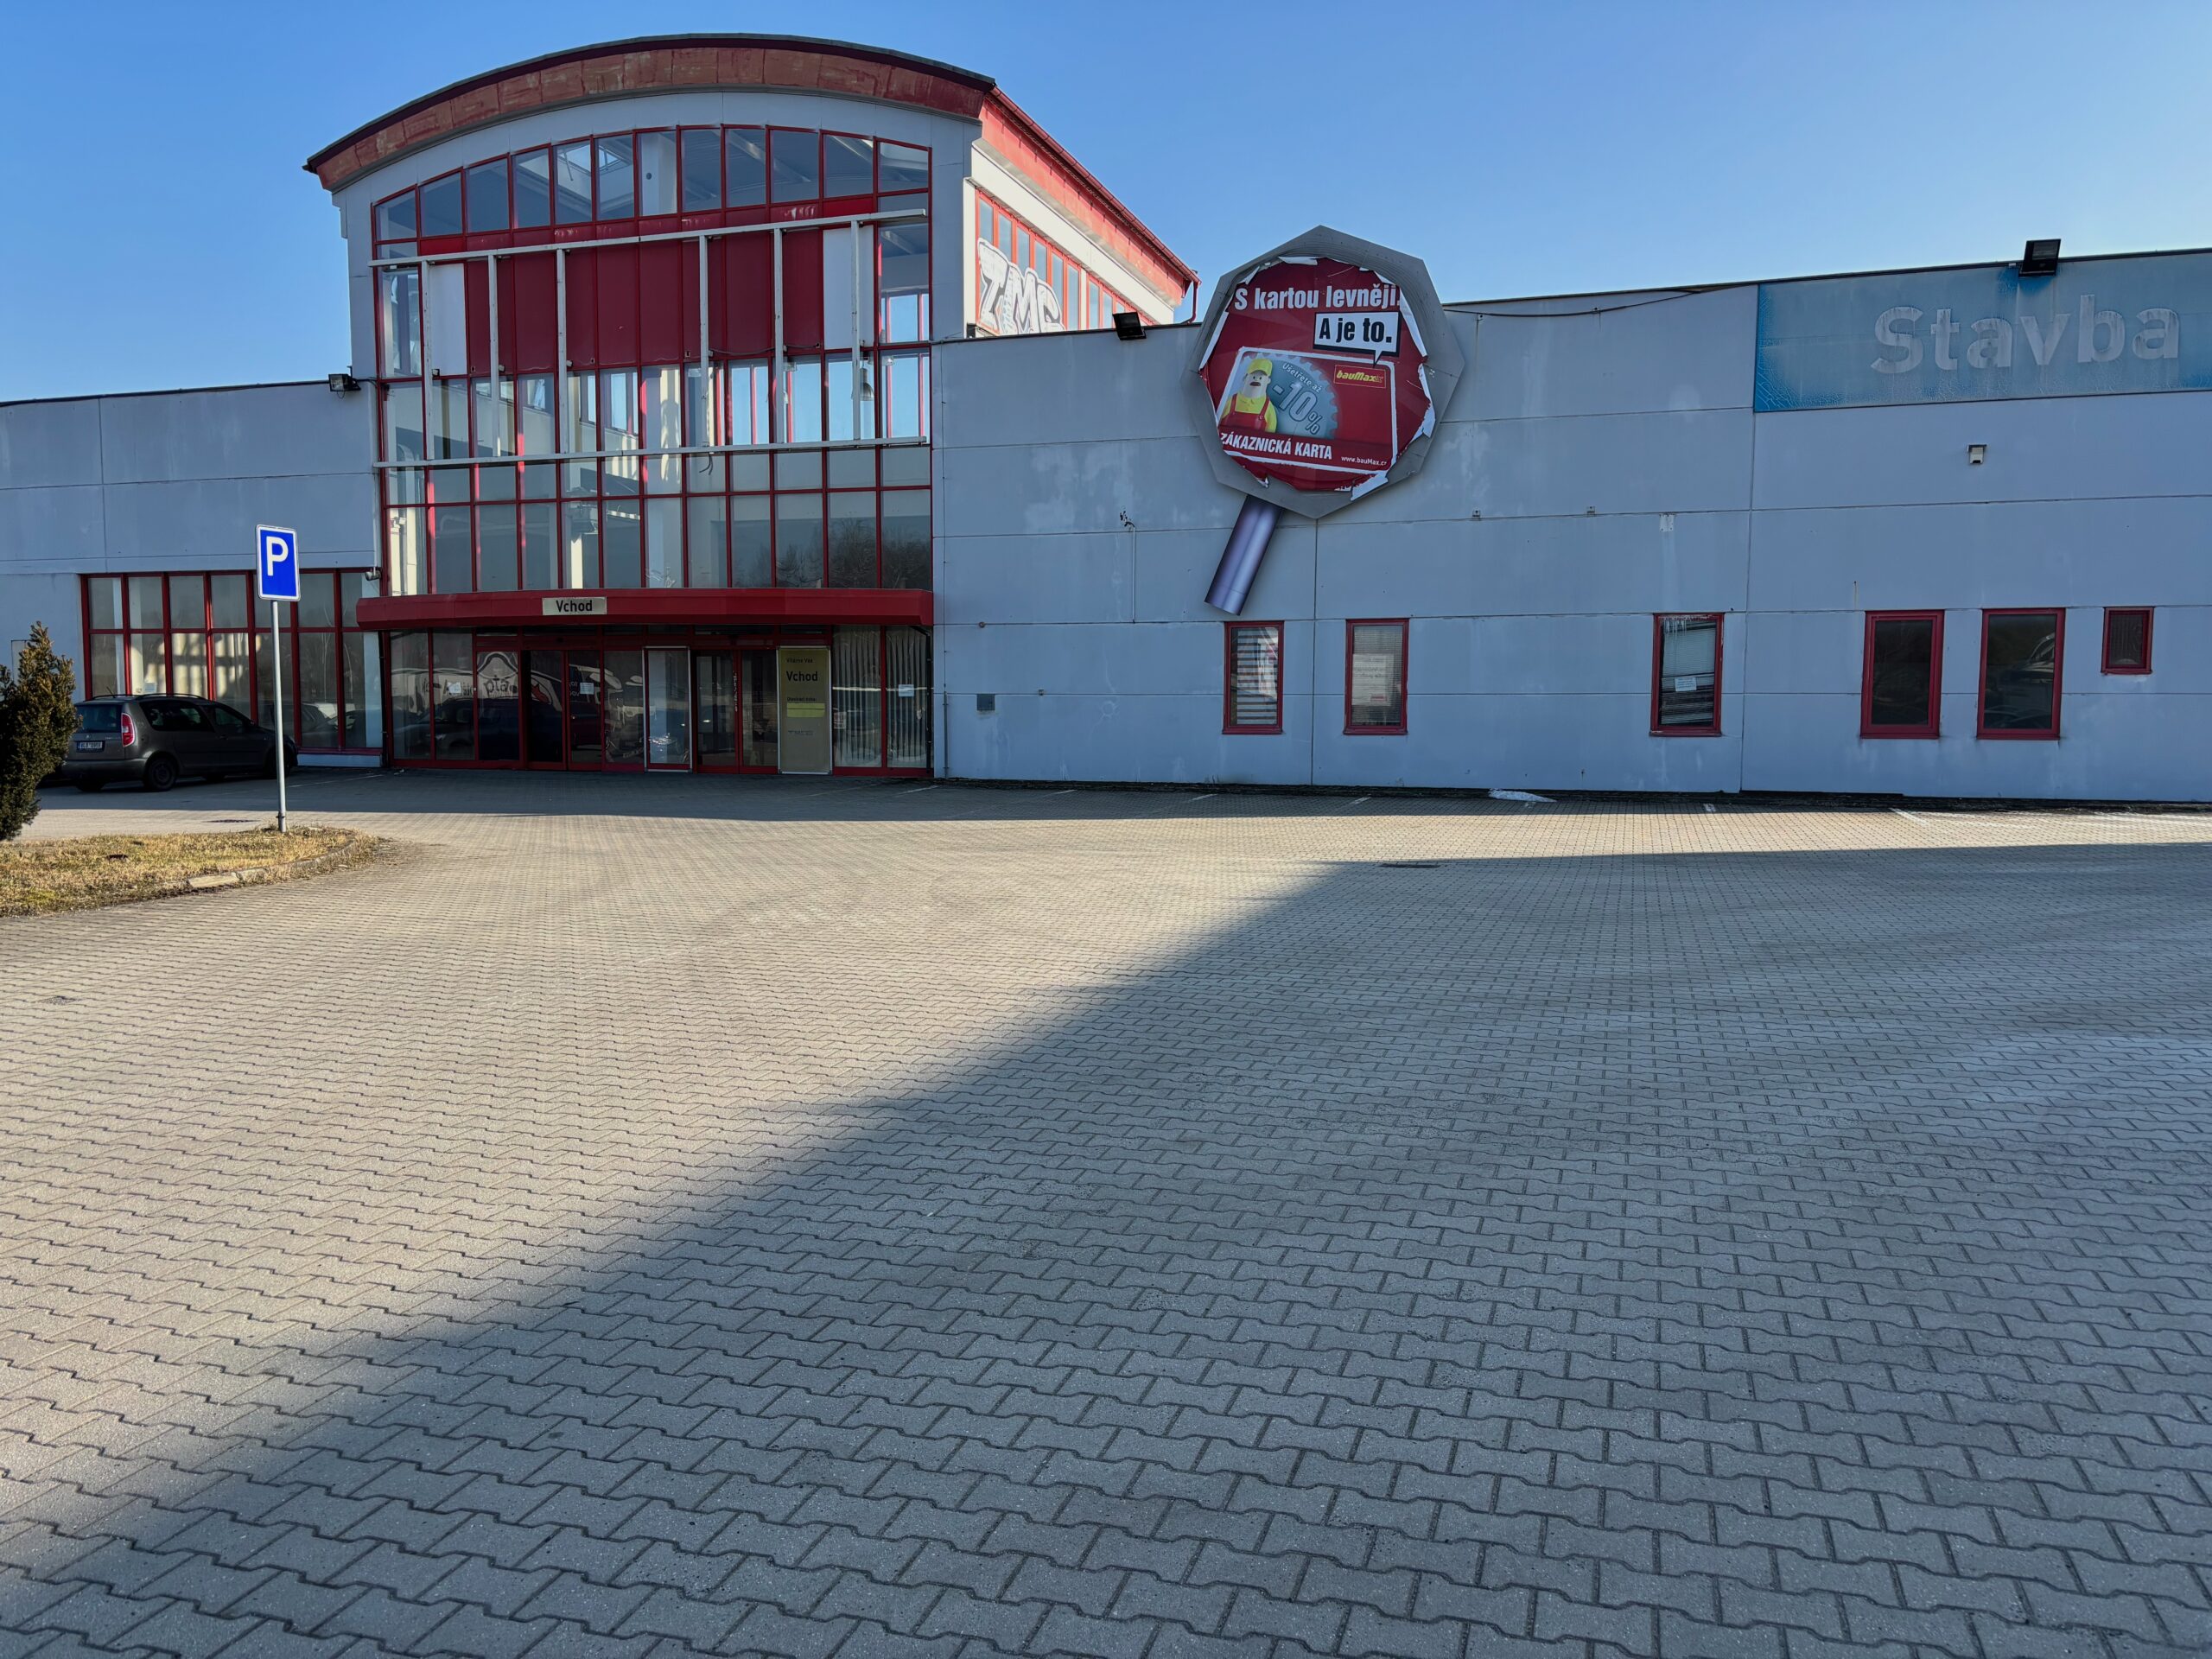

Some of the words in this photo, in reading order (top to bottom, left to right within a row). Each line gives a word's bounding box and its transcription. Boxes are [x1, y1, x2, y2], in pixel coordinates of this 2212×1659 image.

[1234, 288, 1249, 311] S
[1254, 288, 1319, 309] kartou
[1319, 317, 1332, 340] A
[1336, 317, 1357, 344] je
[1363, 317, 1392, 343] to.
[1870, 295, 2180, 374] Stavba
[1281, 362, 1313, 386] Ušetřete
[1312, 383, 1324, 394] až
[1220, 431, 1293, 455] ZÁKAZNICKÁ
[1294, 442, 1333, 461] KARTA
[266, 536, 289, 577] P
[556, 600, 593, 613] Vchod
[786, 671, 817, 682] Vchod
